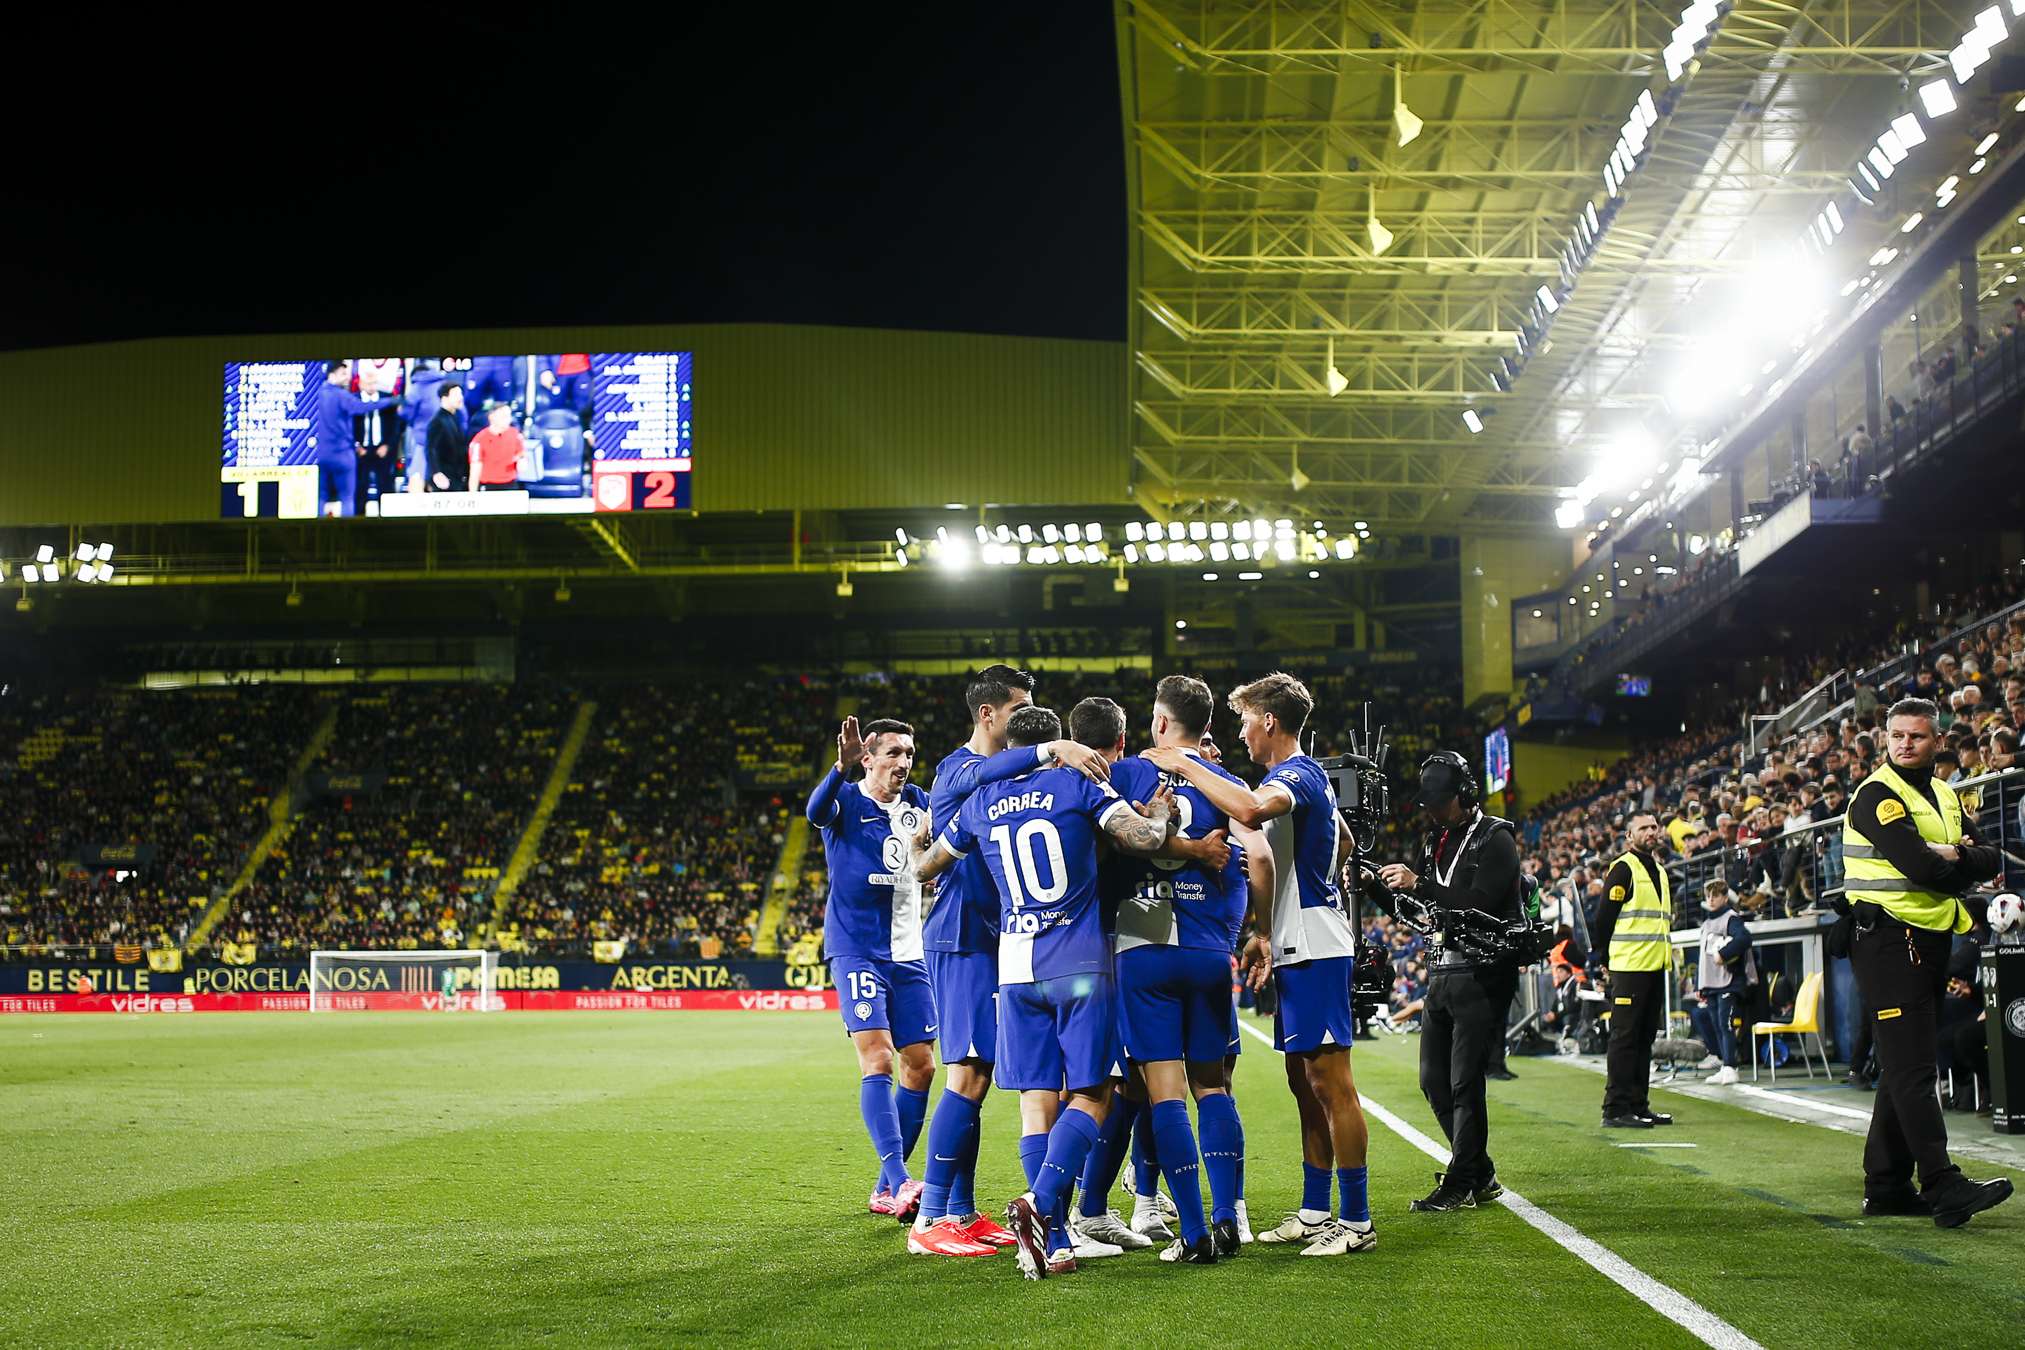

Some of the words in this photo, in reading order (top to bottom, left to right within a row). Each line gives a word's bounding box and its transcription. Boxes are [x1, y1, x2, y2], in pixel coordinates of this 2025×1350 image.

[238, 482, 258, 517] 1
[644, 473, 676, 508] 2
[987, 791, 1054, 821] CORREA
[989, 818, 1069, 908] 10
[1135, 872, 1174, 899] ria
[1175, 881, 1204, 892] Money
[1176, 891, 1206, 901] Transfer
[1005, 906, 1040, 934] ria
[27, 969, 150, 992] BESTILE
[847, 971, 877, 1000] 15
[27, 999, 57, 1012] TILES
[111, 994, 194, 1012] vidres
[739, 991, 826, 1010] vidres
